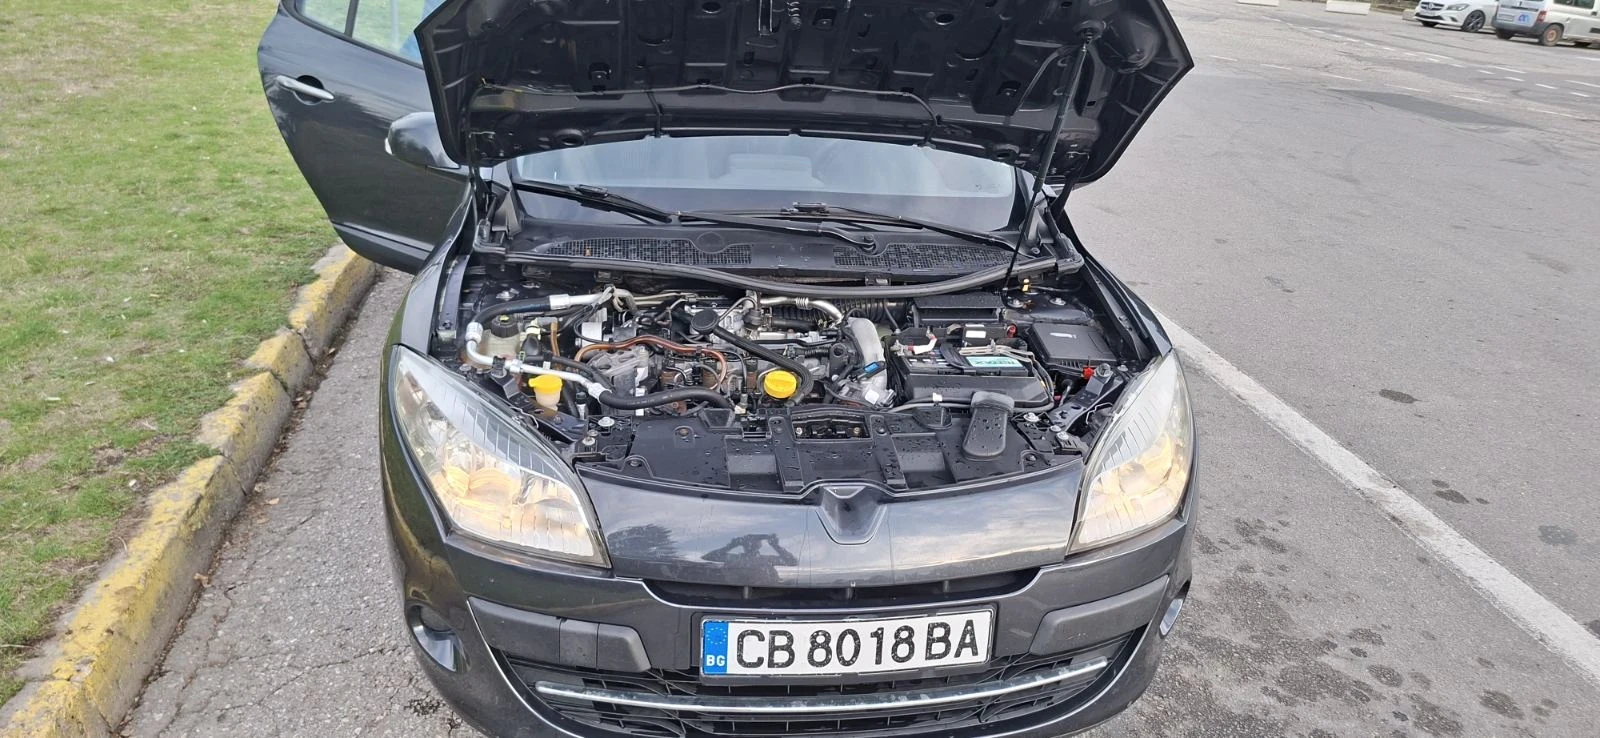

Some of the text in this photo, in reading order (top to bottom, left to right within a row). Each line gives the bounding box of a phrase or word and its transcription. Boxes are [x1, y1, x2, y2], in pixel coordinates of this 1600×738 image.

[737, 619, 979, 669] CB 8018 BA
[706, 654, 726, 667] BG
